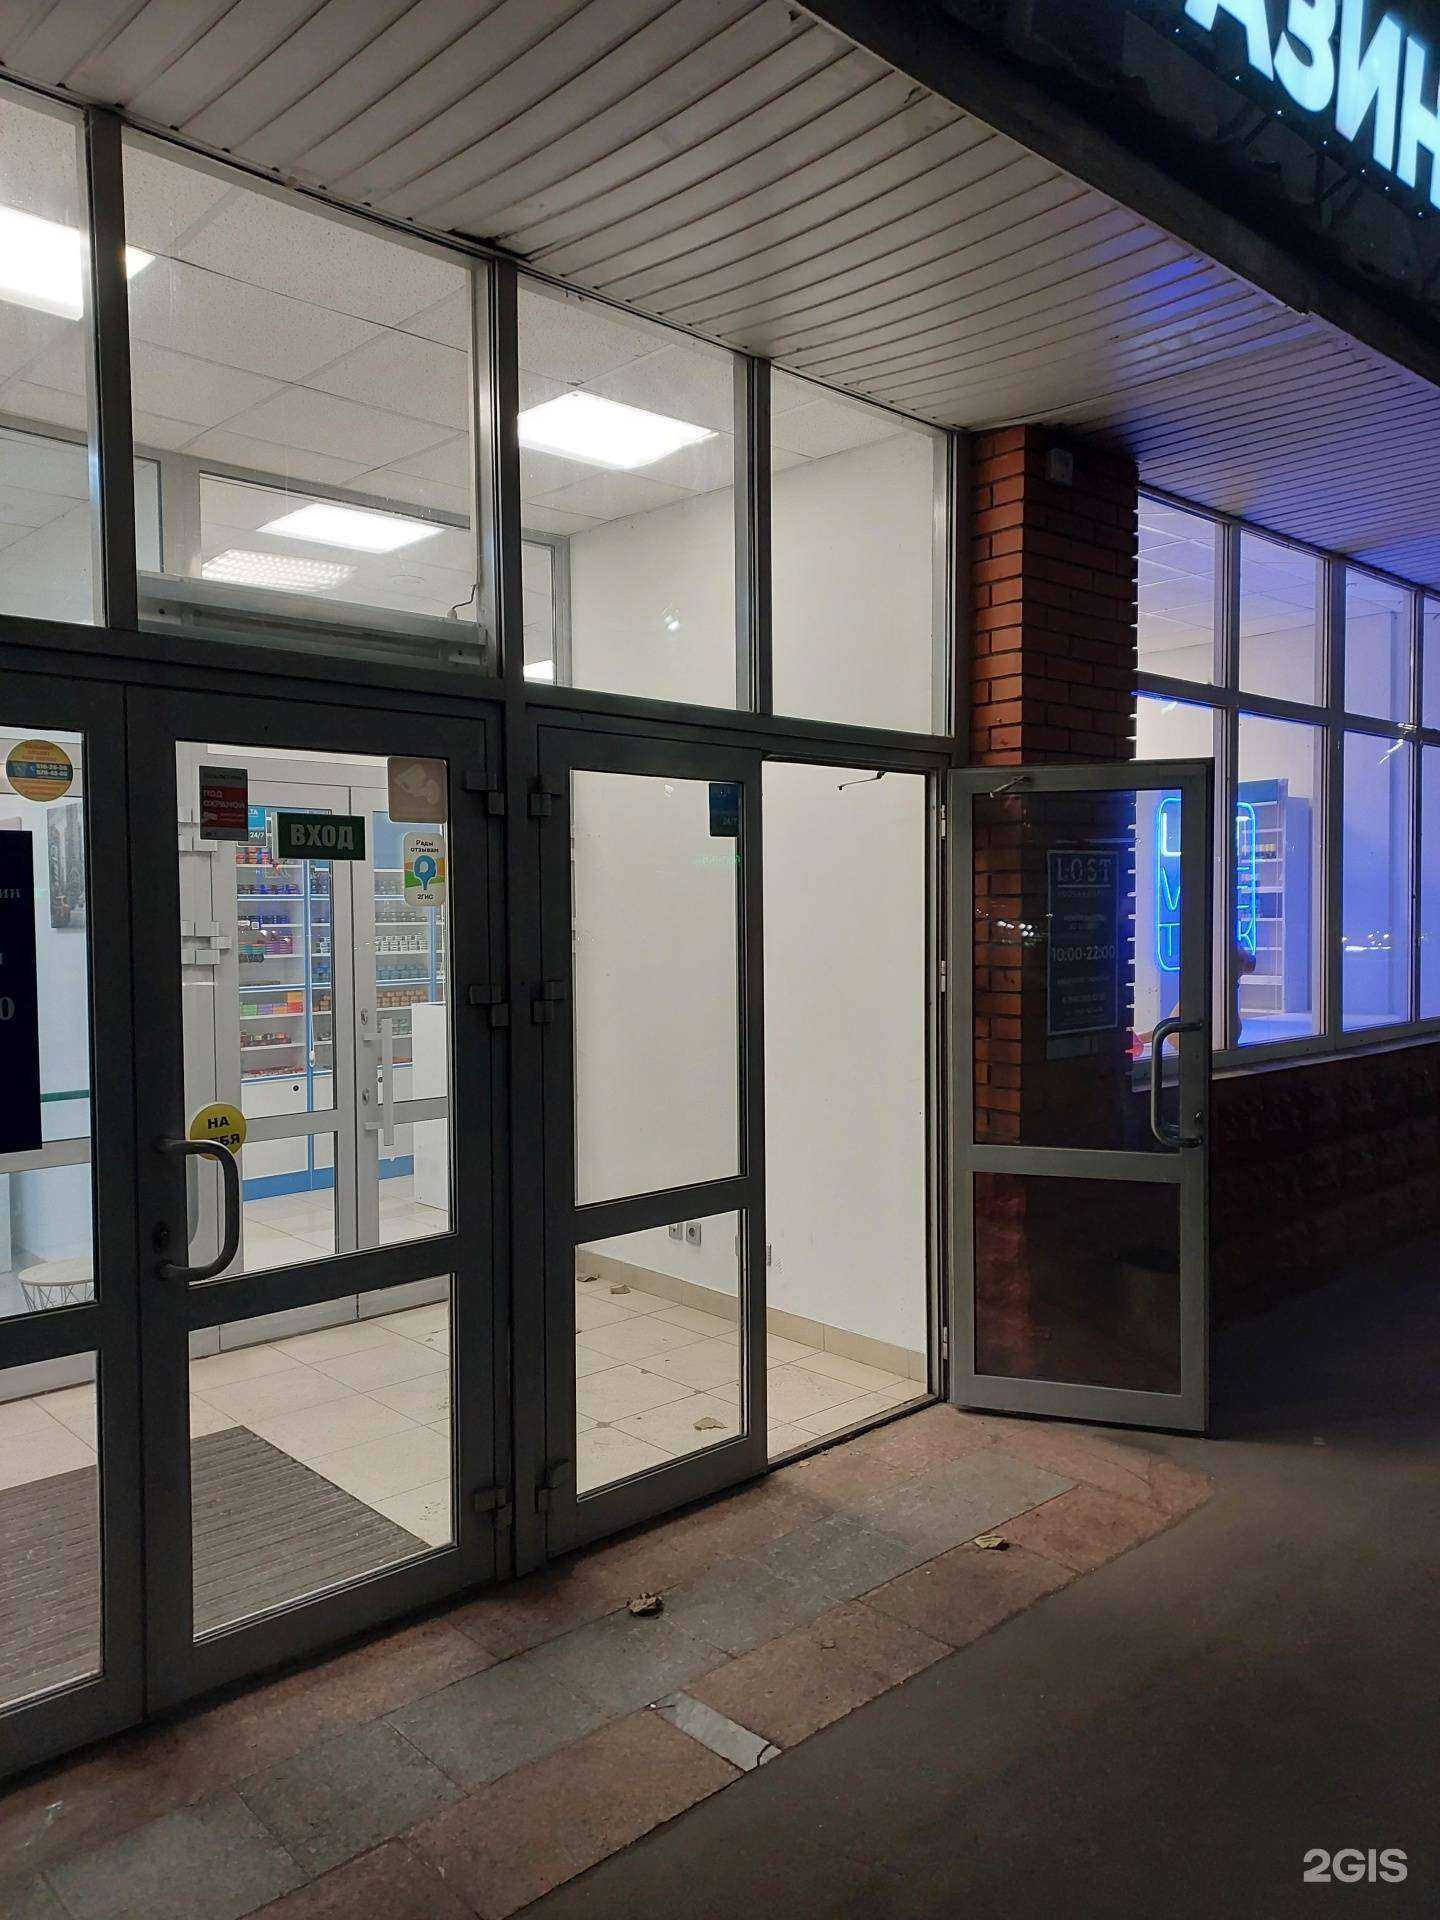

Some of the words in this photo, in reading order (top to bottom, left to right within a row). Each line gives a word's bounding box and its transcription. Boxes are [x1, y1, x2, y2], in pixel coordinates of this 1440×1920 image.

[290, 823, 354, 850] ВХОД
[416, 839, 434, 847] Рады
[1057, 858, 1111, 881] LOST
[417, 893, 434, 901] 2ГИС
[207, 1116, 230, 1129] НА
